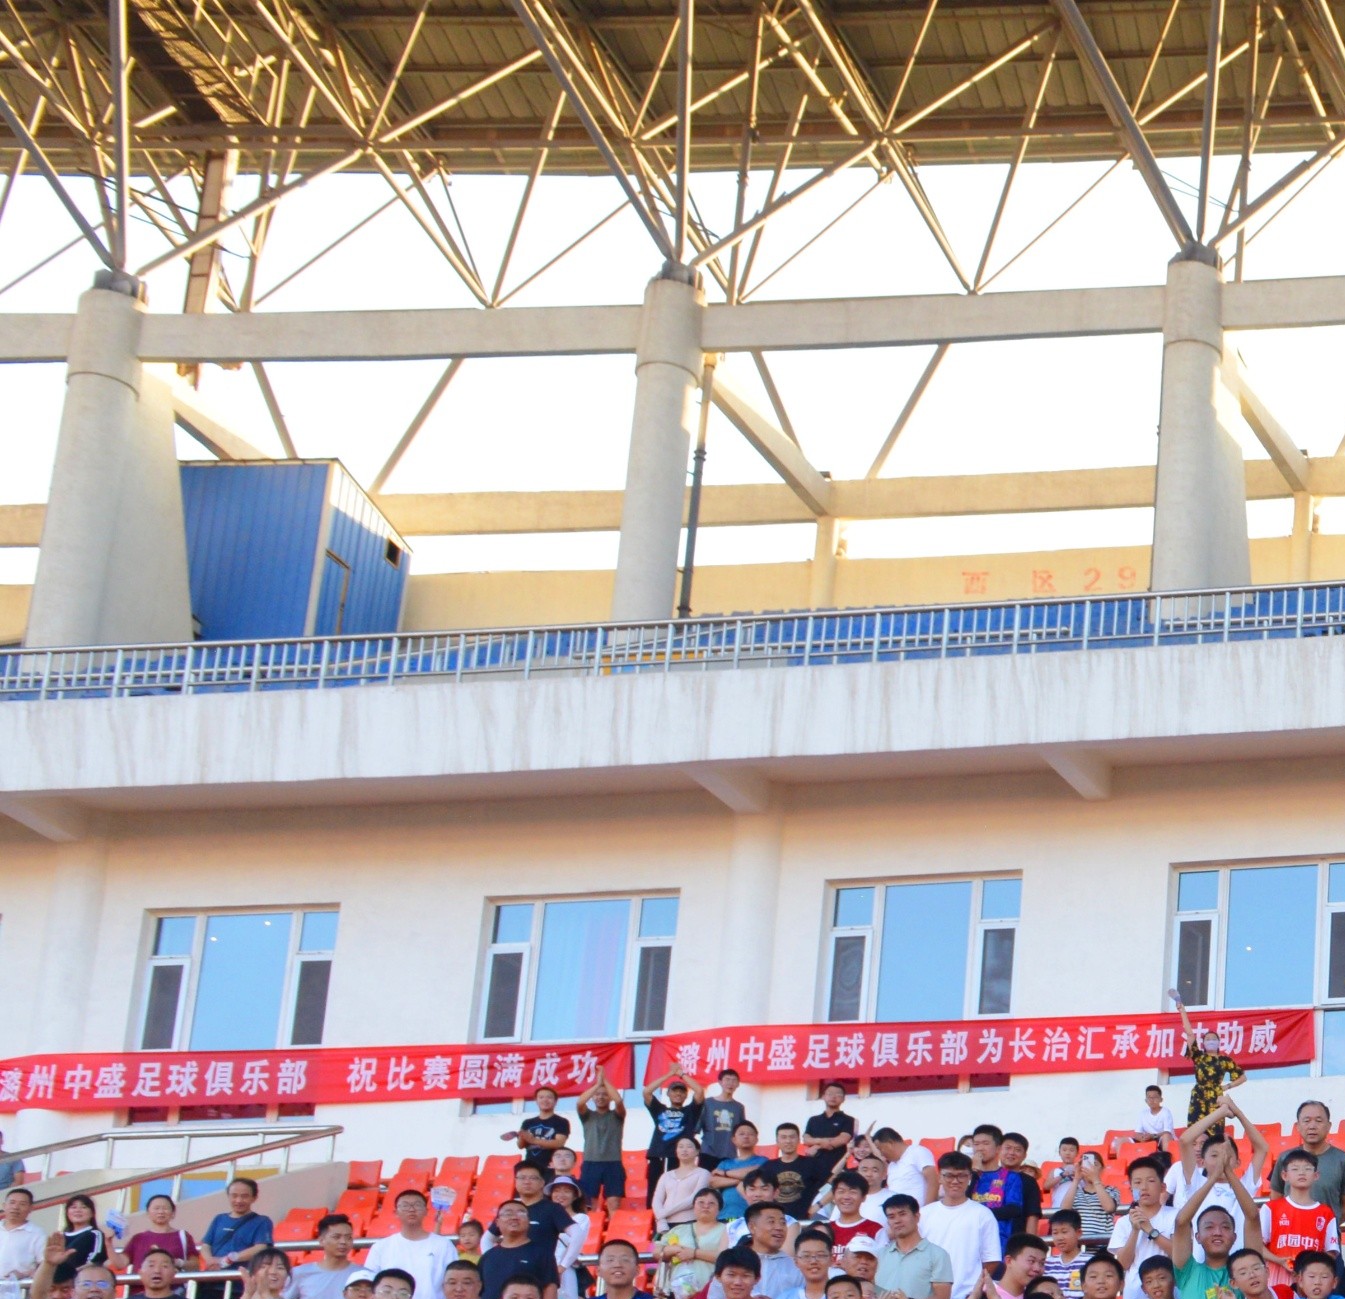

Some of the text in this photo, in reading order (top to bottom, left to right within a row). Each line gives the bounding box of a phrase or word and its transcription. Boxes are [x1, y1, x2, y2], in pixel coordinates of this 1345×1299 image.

[347, 1050, 598, 1092] 祝比赛圆满成功
